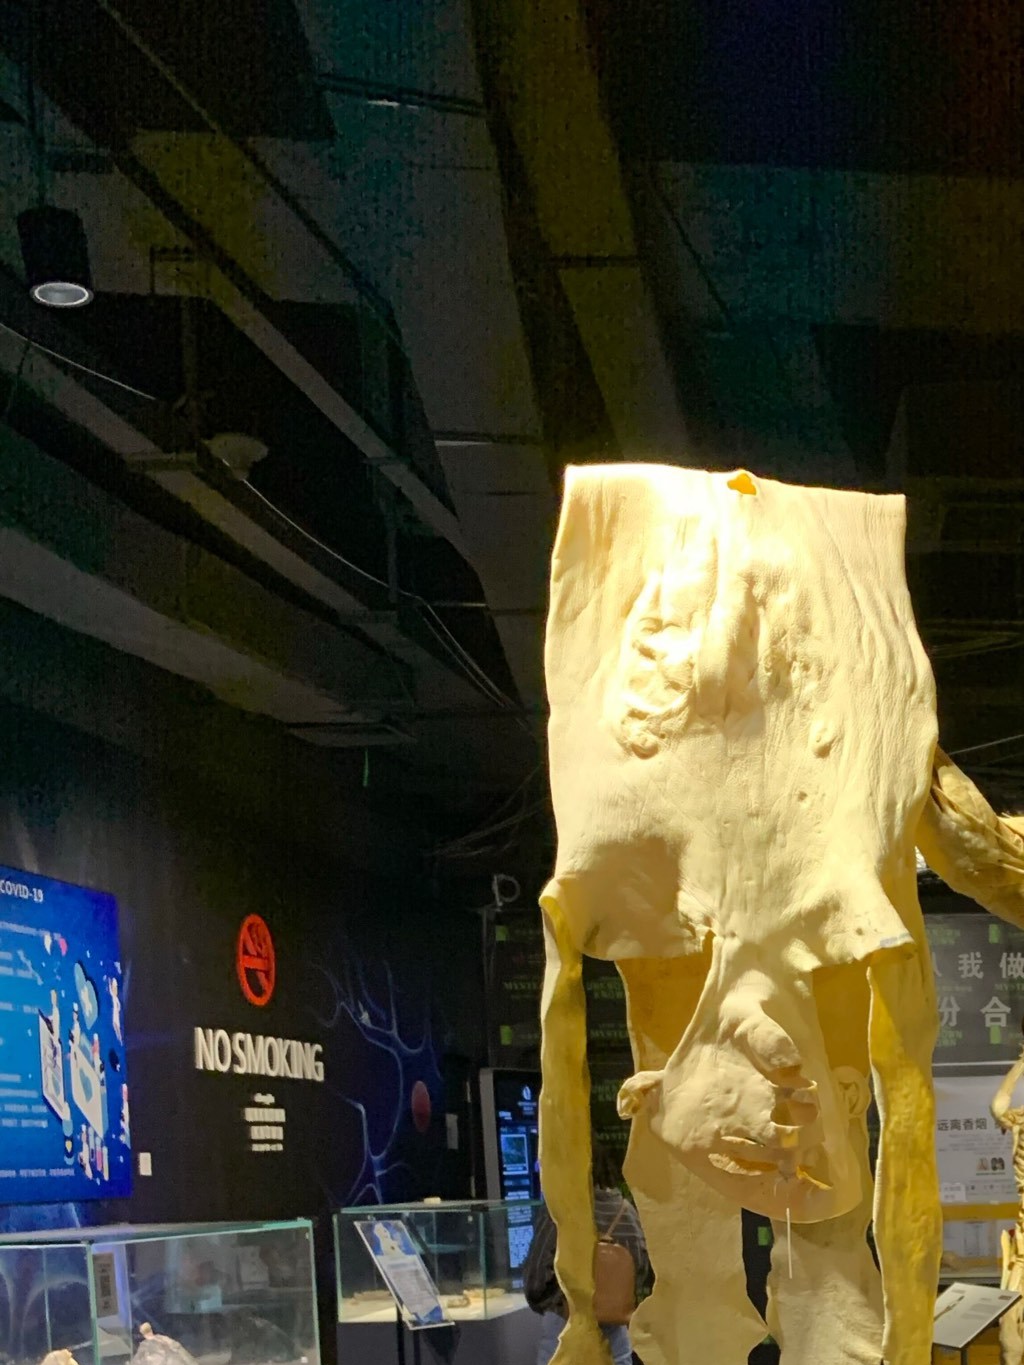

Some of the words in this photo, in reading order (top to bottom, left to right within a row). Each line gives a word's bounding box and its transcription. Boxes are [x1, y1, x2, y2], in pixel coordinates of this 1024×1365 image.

[0, 880, 43, 902] COVID-19
[194, 1027, 231, 1072] NO
[232, 1032, 325, 1082] SMOKING
[938, 1118, 987, 1131] 远离香烟
